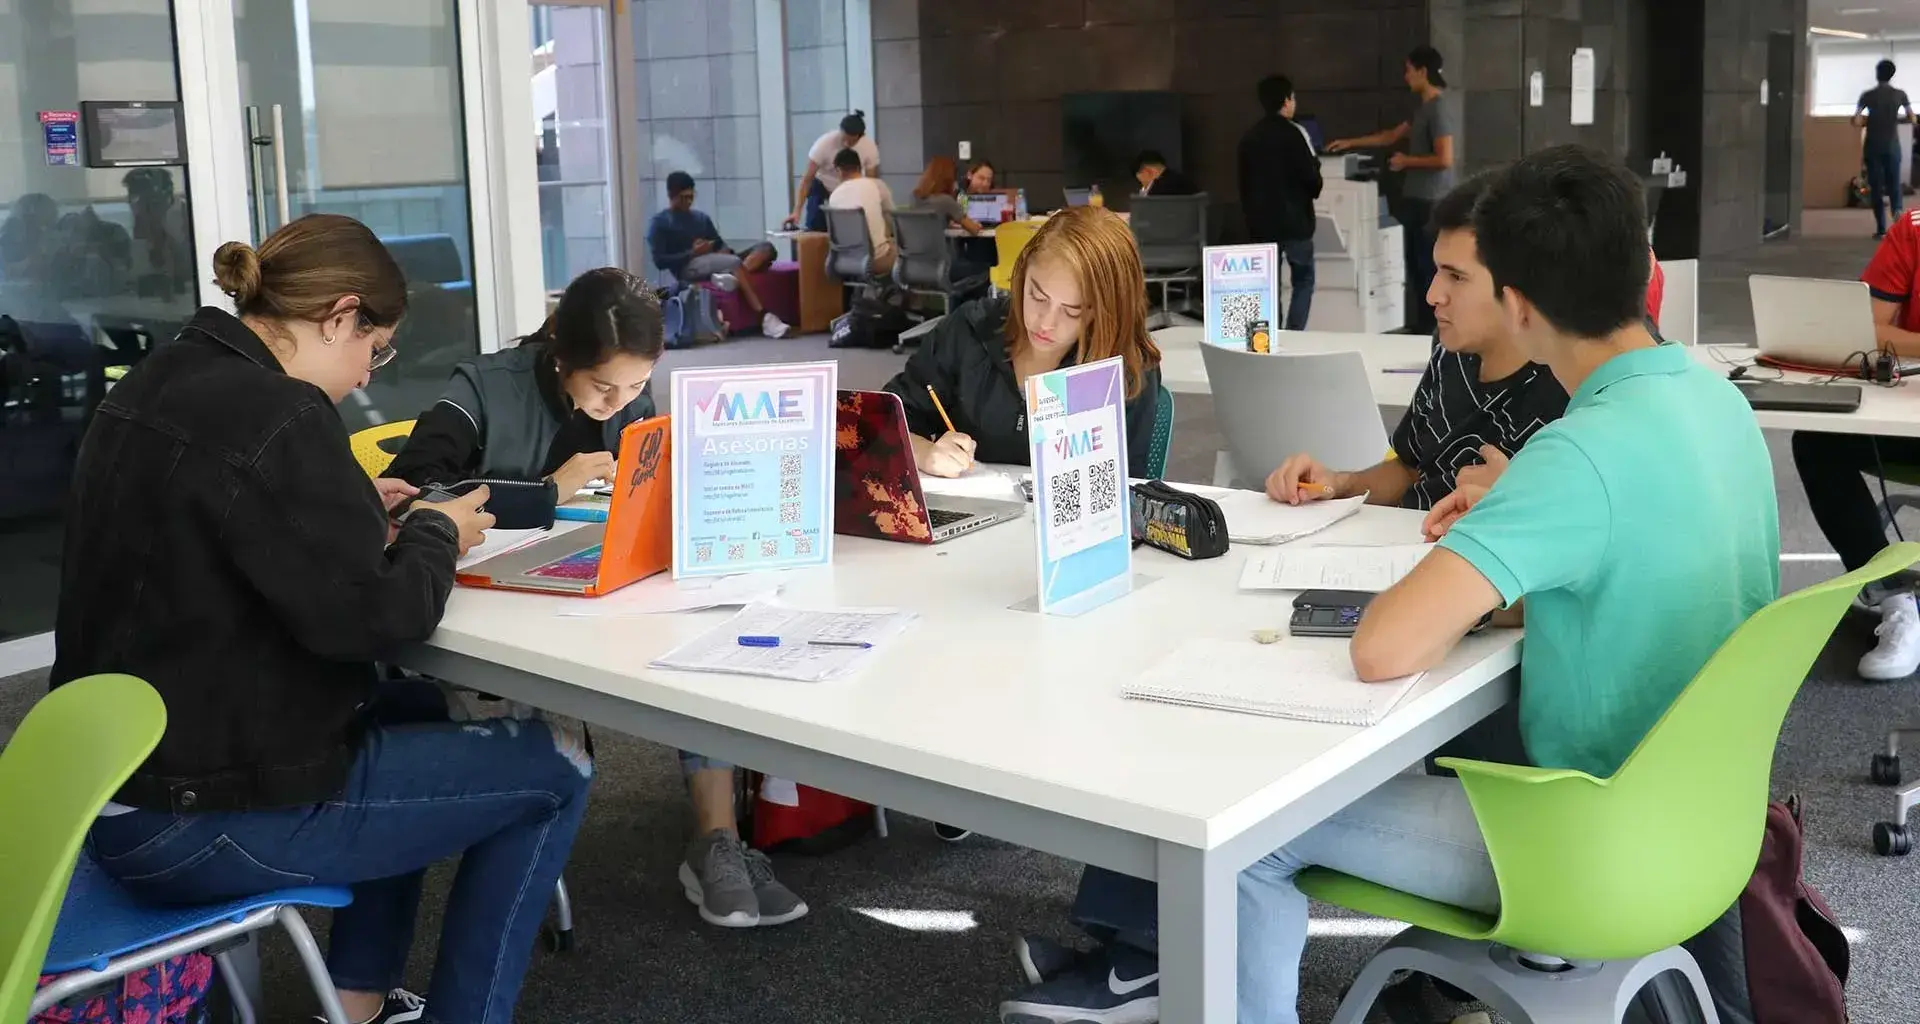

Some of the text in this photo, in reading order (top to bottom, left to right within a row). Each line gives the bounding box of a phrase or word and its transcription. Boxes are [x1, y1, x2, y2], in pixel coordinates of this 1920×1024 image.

[1222, 256, 1263, 271] MAE
[713, 390, 803, 421] MAE
[1063, 424, 1104, 460] MAE
